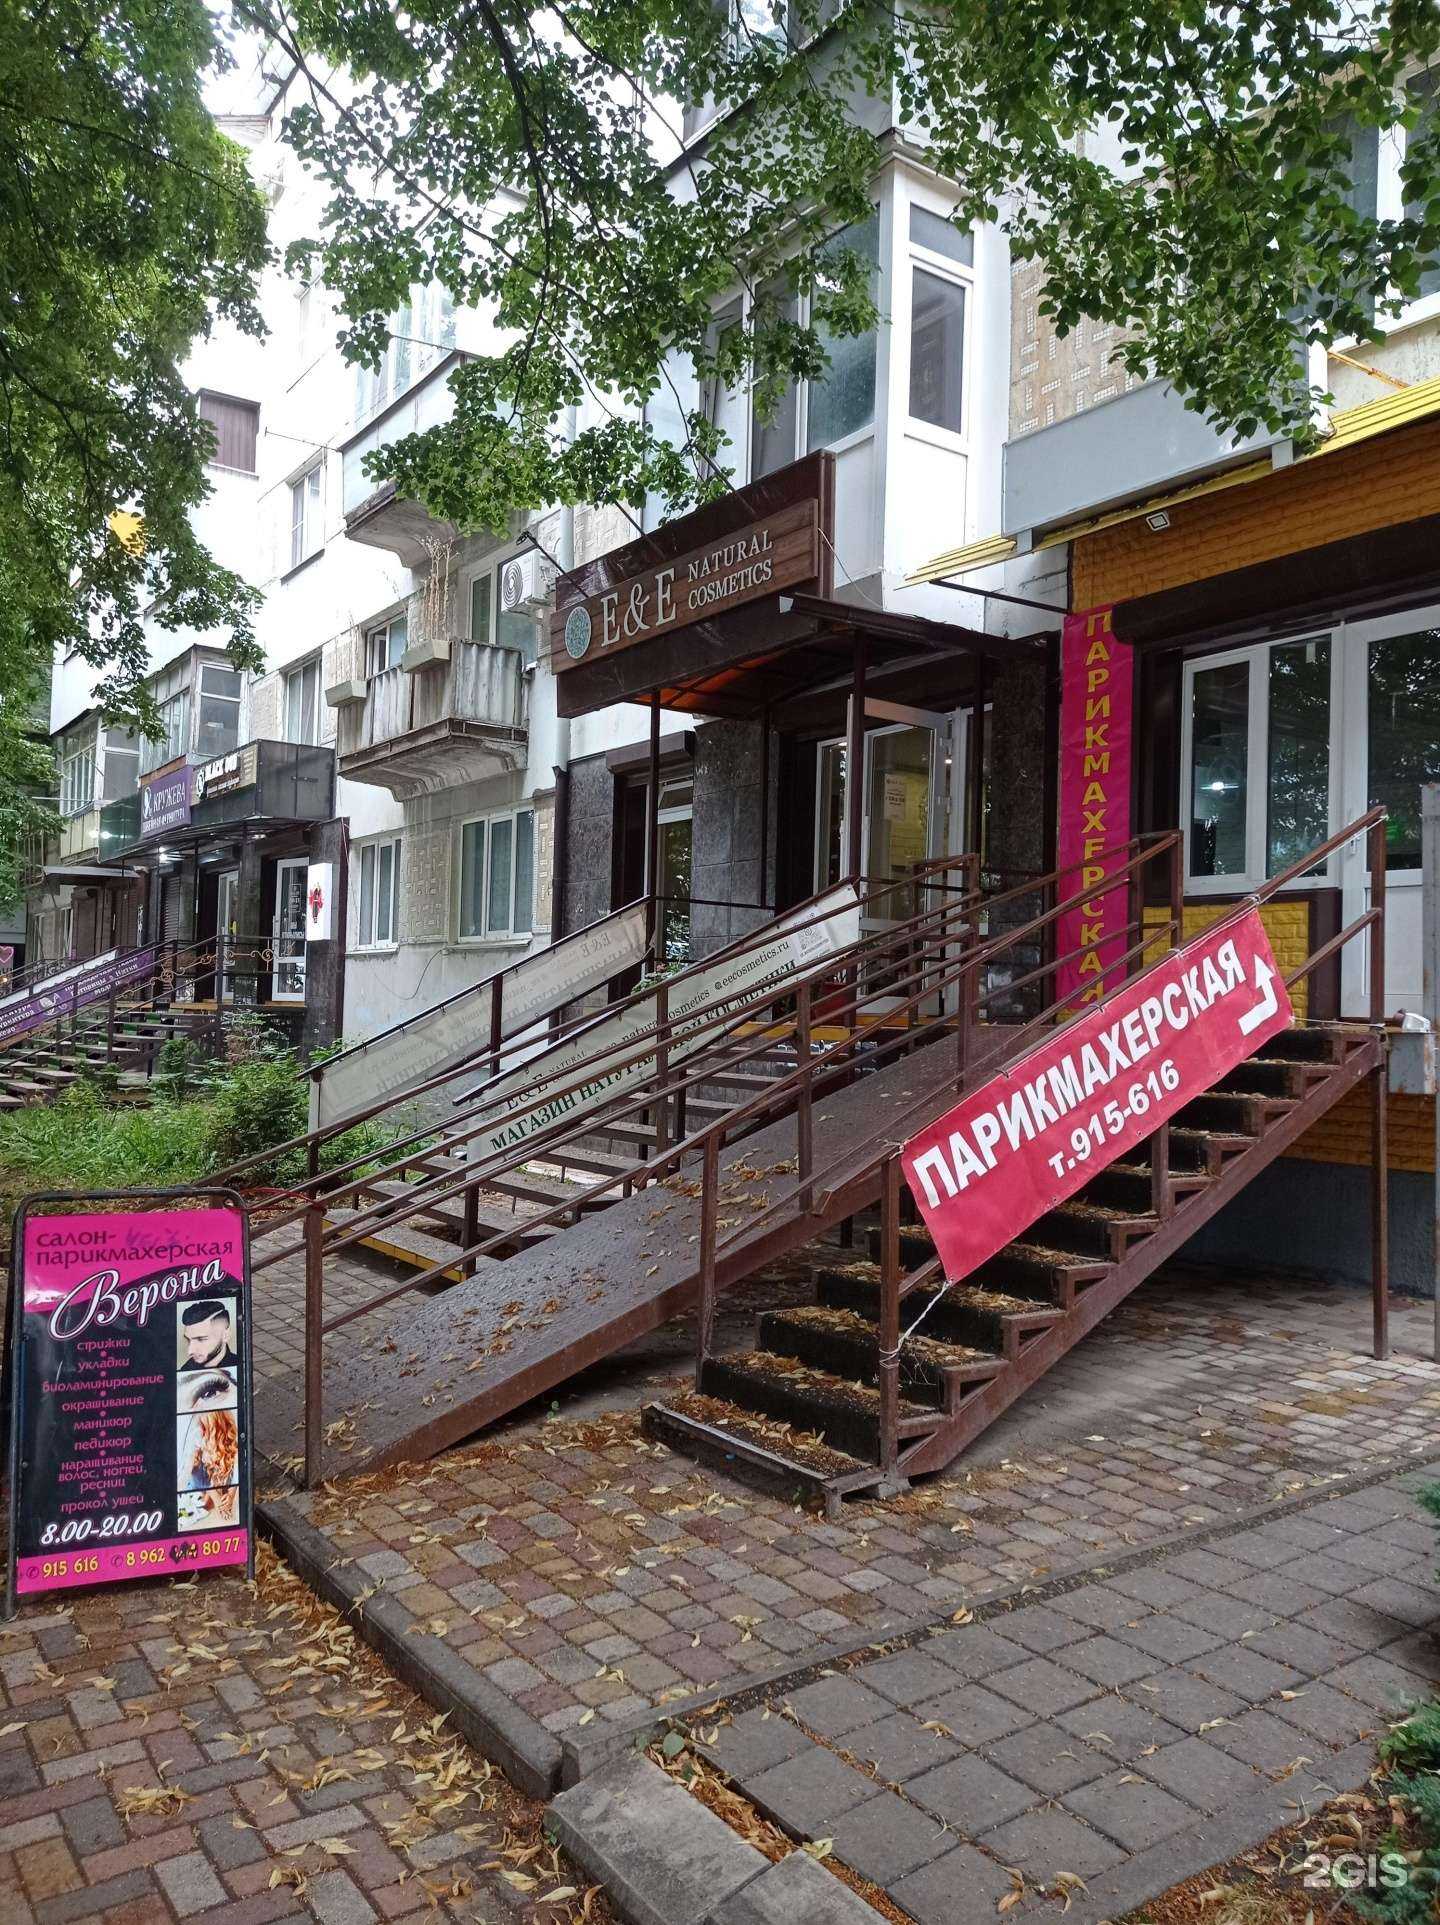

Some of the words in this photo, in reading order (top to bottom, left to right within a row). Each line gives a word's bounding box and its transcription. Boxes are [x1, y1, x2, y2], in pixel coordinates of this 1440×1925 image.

[687, 529, 774, 583] NATURAL
[687, 558, 773, 610] COSMETICS
[600, 568, 677, 649] E&E
[714, 940, 790, 991] @eecosmetics.ru
[912, 938, 1248, 1210] ПАРИКМАХЕРСКАЯ
[489, 1094, 577, 1151] МАГАЗИН
[1048, 1059, 1182, 1179] т.915-616
[36, 1230, 116, 1248] салон-
[36, 1241, 233, 1269] парикмахерская
[49, 1257, 226, 1340] Верона
[76, 1338, 131, 1352] стрижки
[78, 1356, 130, 1373] укладки
[42, 1374, 165, 1393] биоламинирование
[61, 1395, 145, 1413] окрашивание
[73, 1416, 132, 1431] маникюр
[74, 1436, 132, 1451] педикюр
[61, 1454, 145, 1472] наращивание
[61, 1496, 108, 1514] прокол
[112, 1493, 145, 1509] ушей
[40, 1510, 164, 1546] 8.00-20.00
[42, 1560, 68, 1579] 915
[73, 1556, 99, 1574] 616
[126, 1552, 136, 1567] 8
[140, 1548, 166, 1564] 962
[202, 1540, 221, 1556] 80
[224, 1537, 240, 1553] 77
